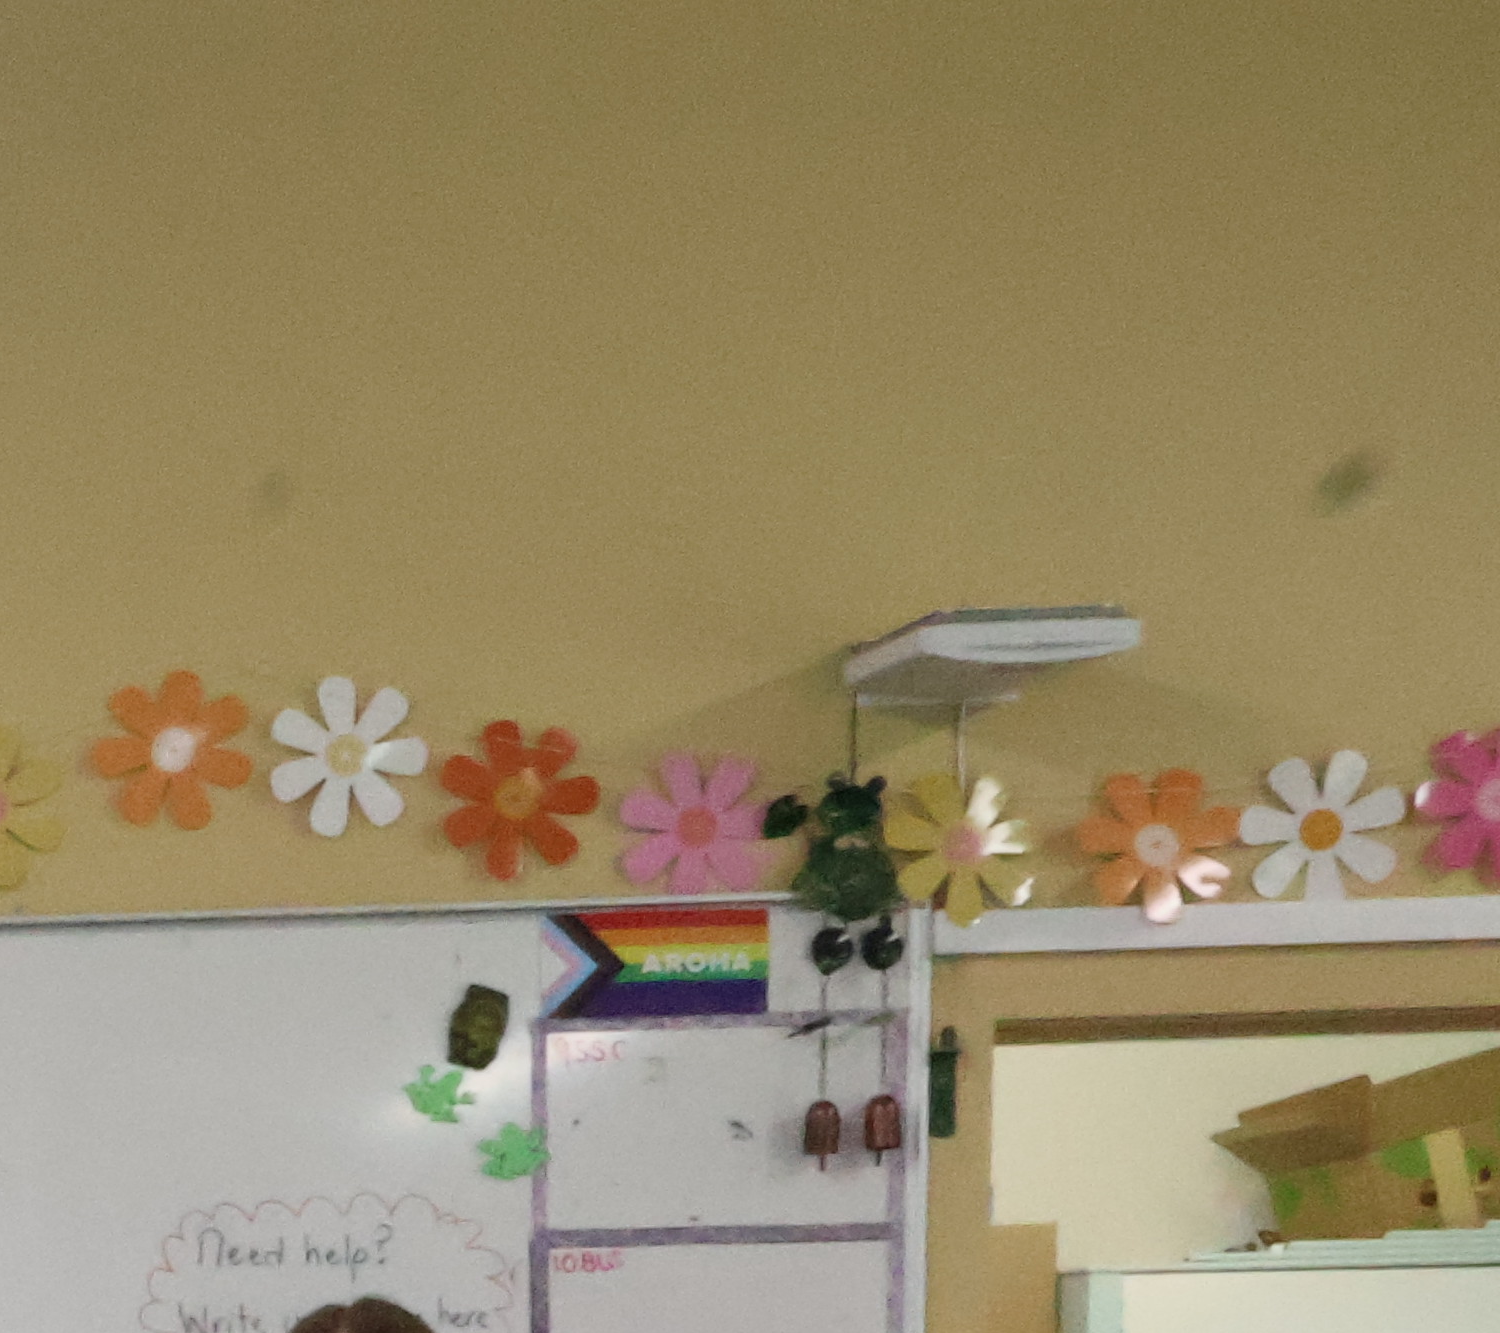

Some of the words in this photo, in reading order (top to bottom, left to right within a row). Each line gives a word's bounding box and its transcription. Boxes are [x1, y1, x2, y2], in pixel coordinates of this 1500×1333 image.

[642, 953, 750, 973] AROHA
[198, 1227, 285, 1267] Need
[305, 1223, 393, 1283] help?
[438, 1298, 489, 1329] here
